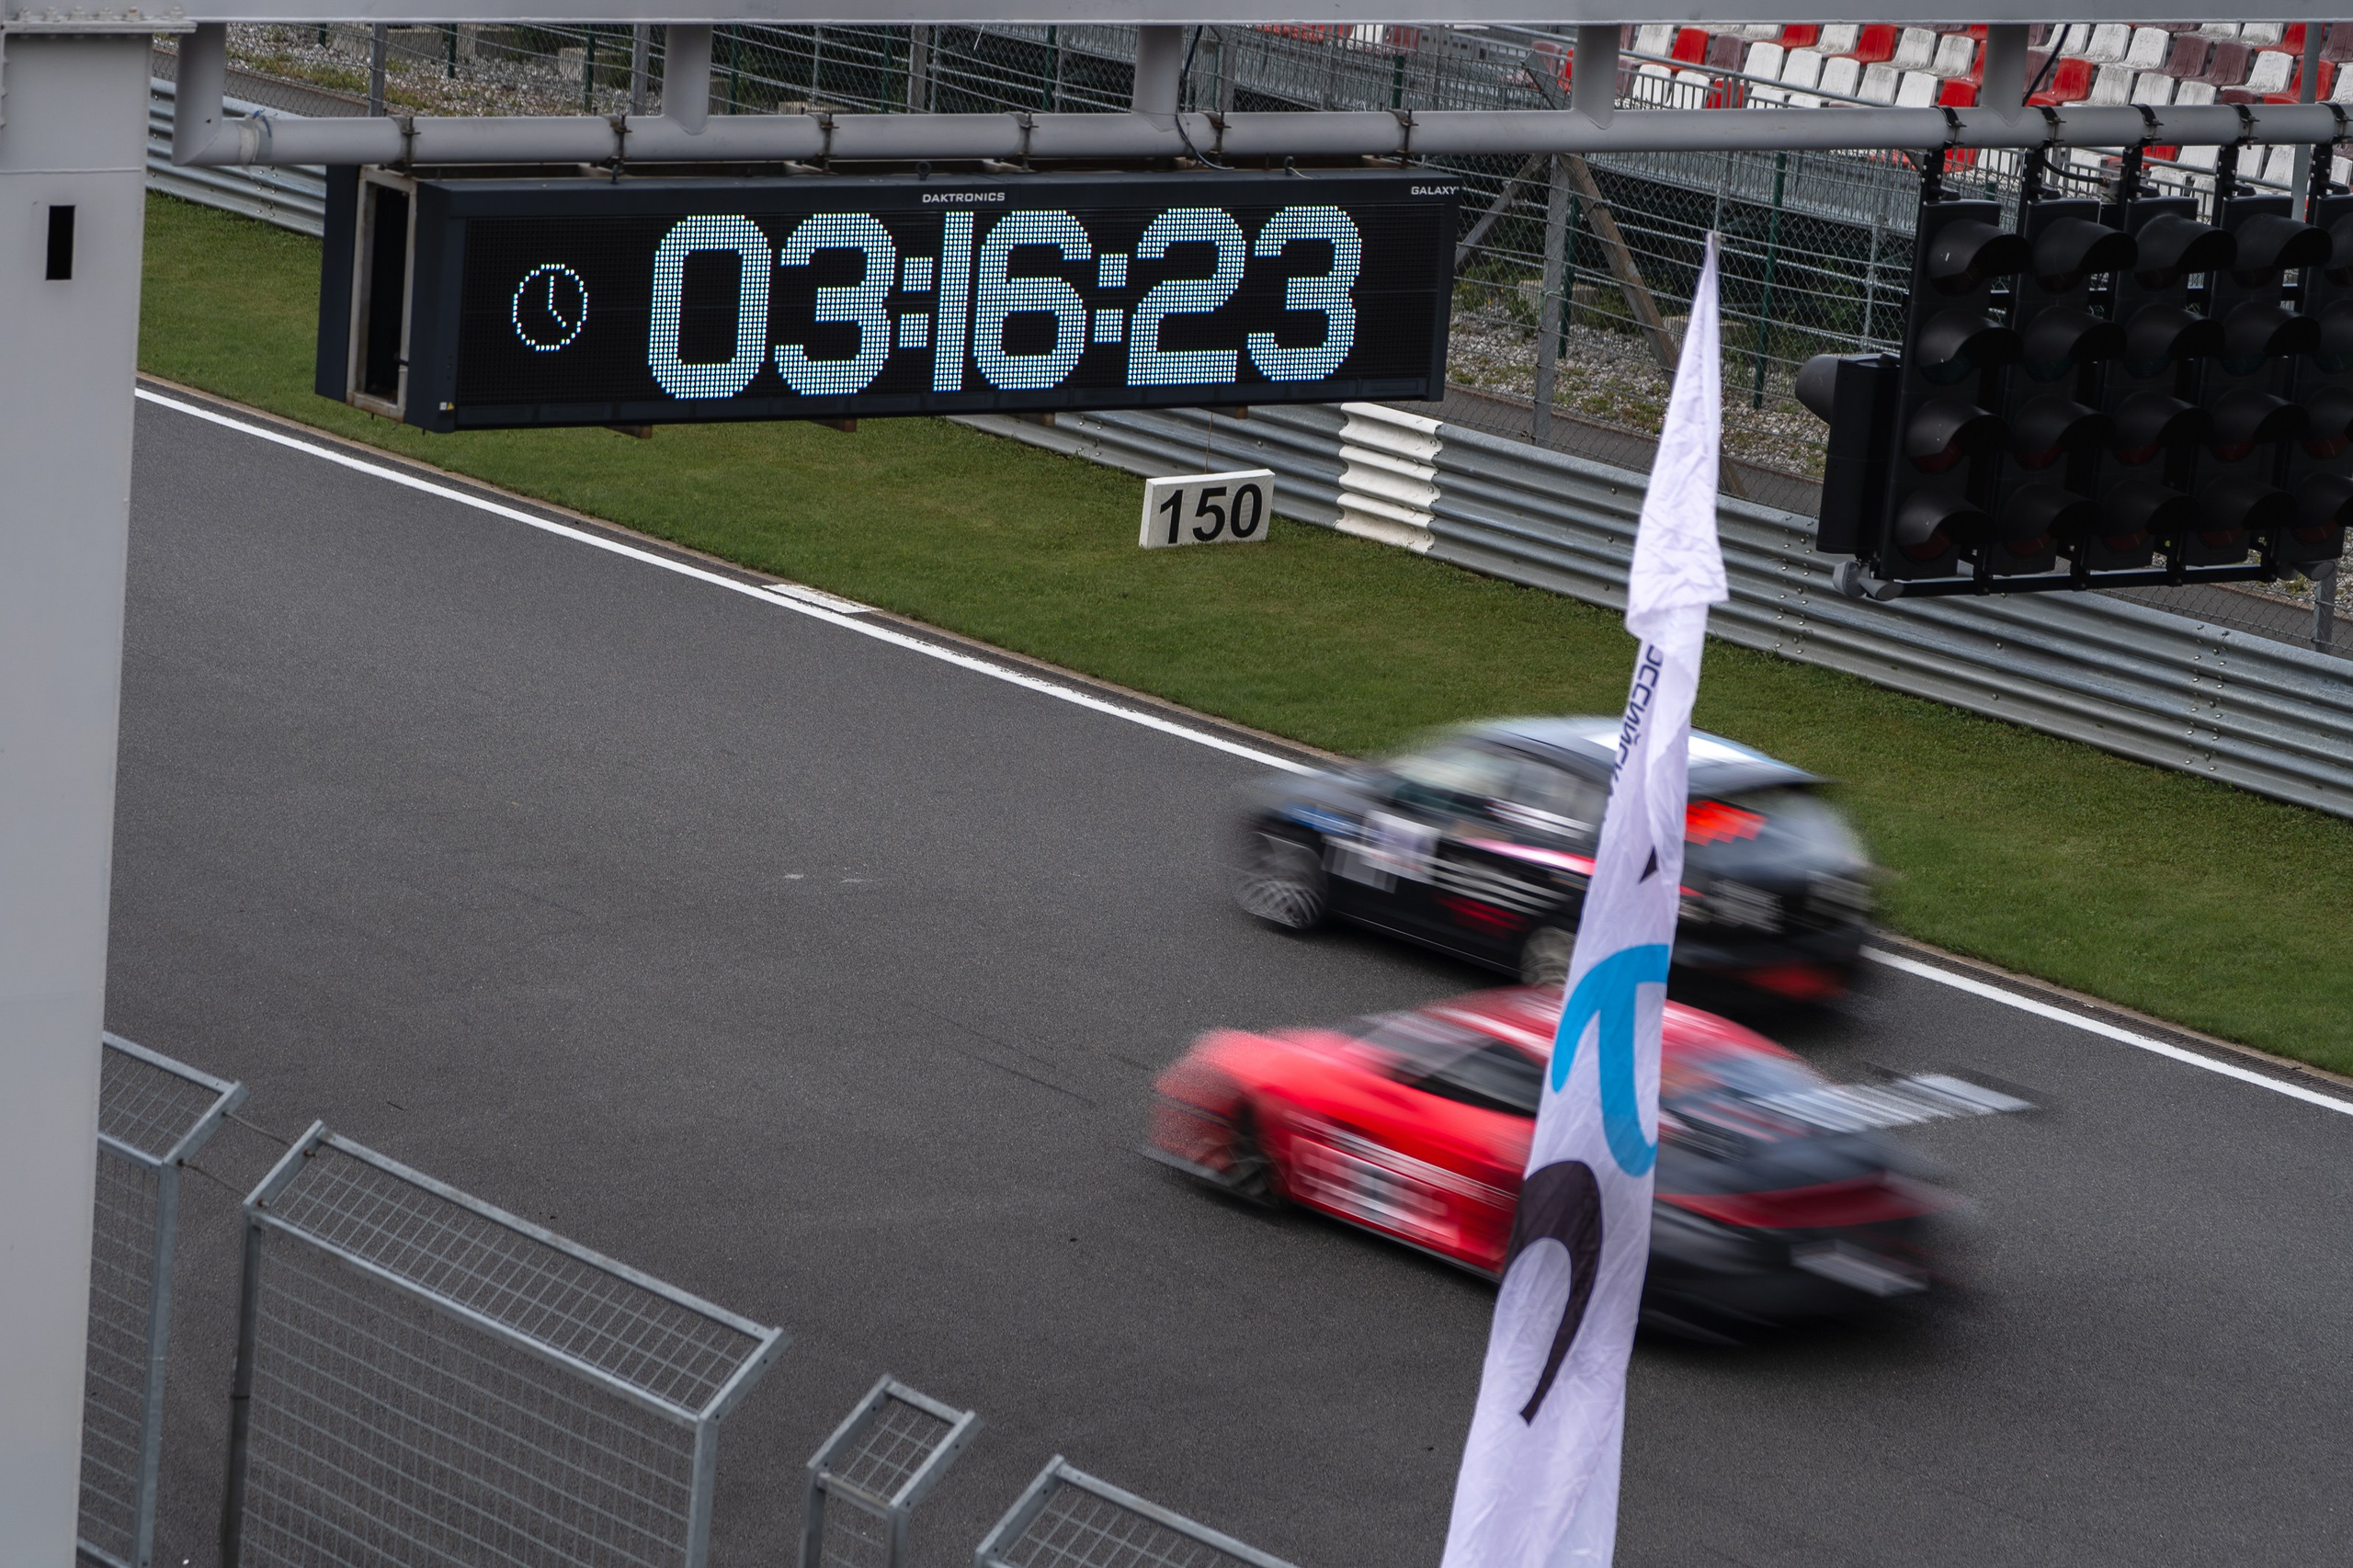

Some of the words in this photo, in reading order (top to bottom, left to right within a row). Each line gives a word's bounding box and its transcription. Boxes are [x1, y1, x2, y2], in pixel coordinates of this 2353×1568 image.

[922, 192, 1006, 203] DAKTRONICS
[1411, 186, 1458, 195] GALAXY
[648, 205, 1362, 400] 03:16:23
[1159, 483, 1263, 545] 150
